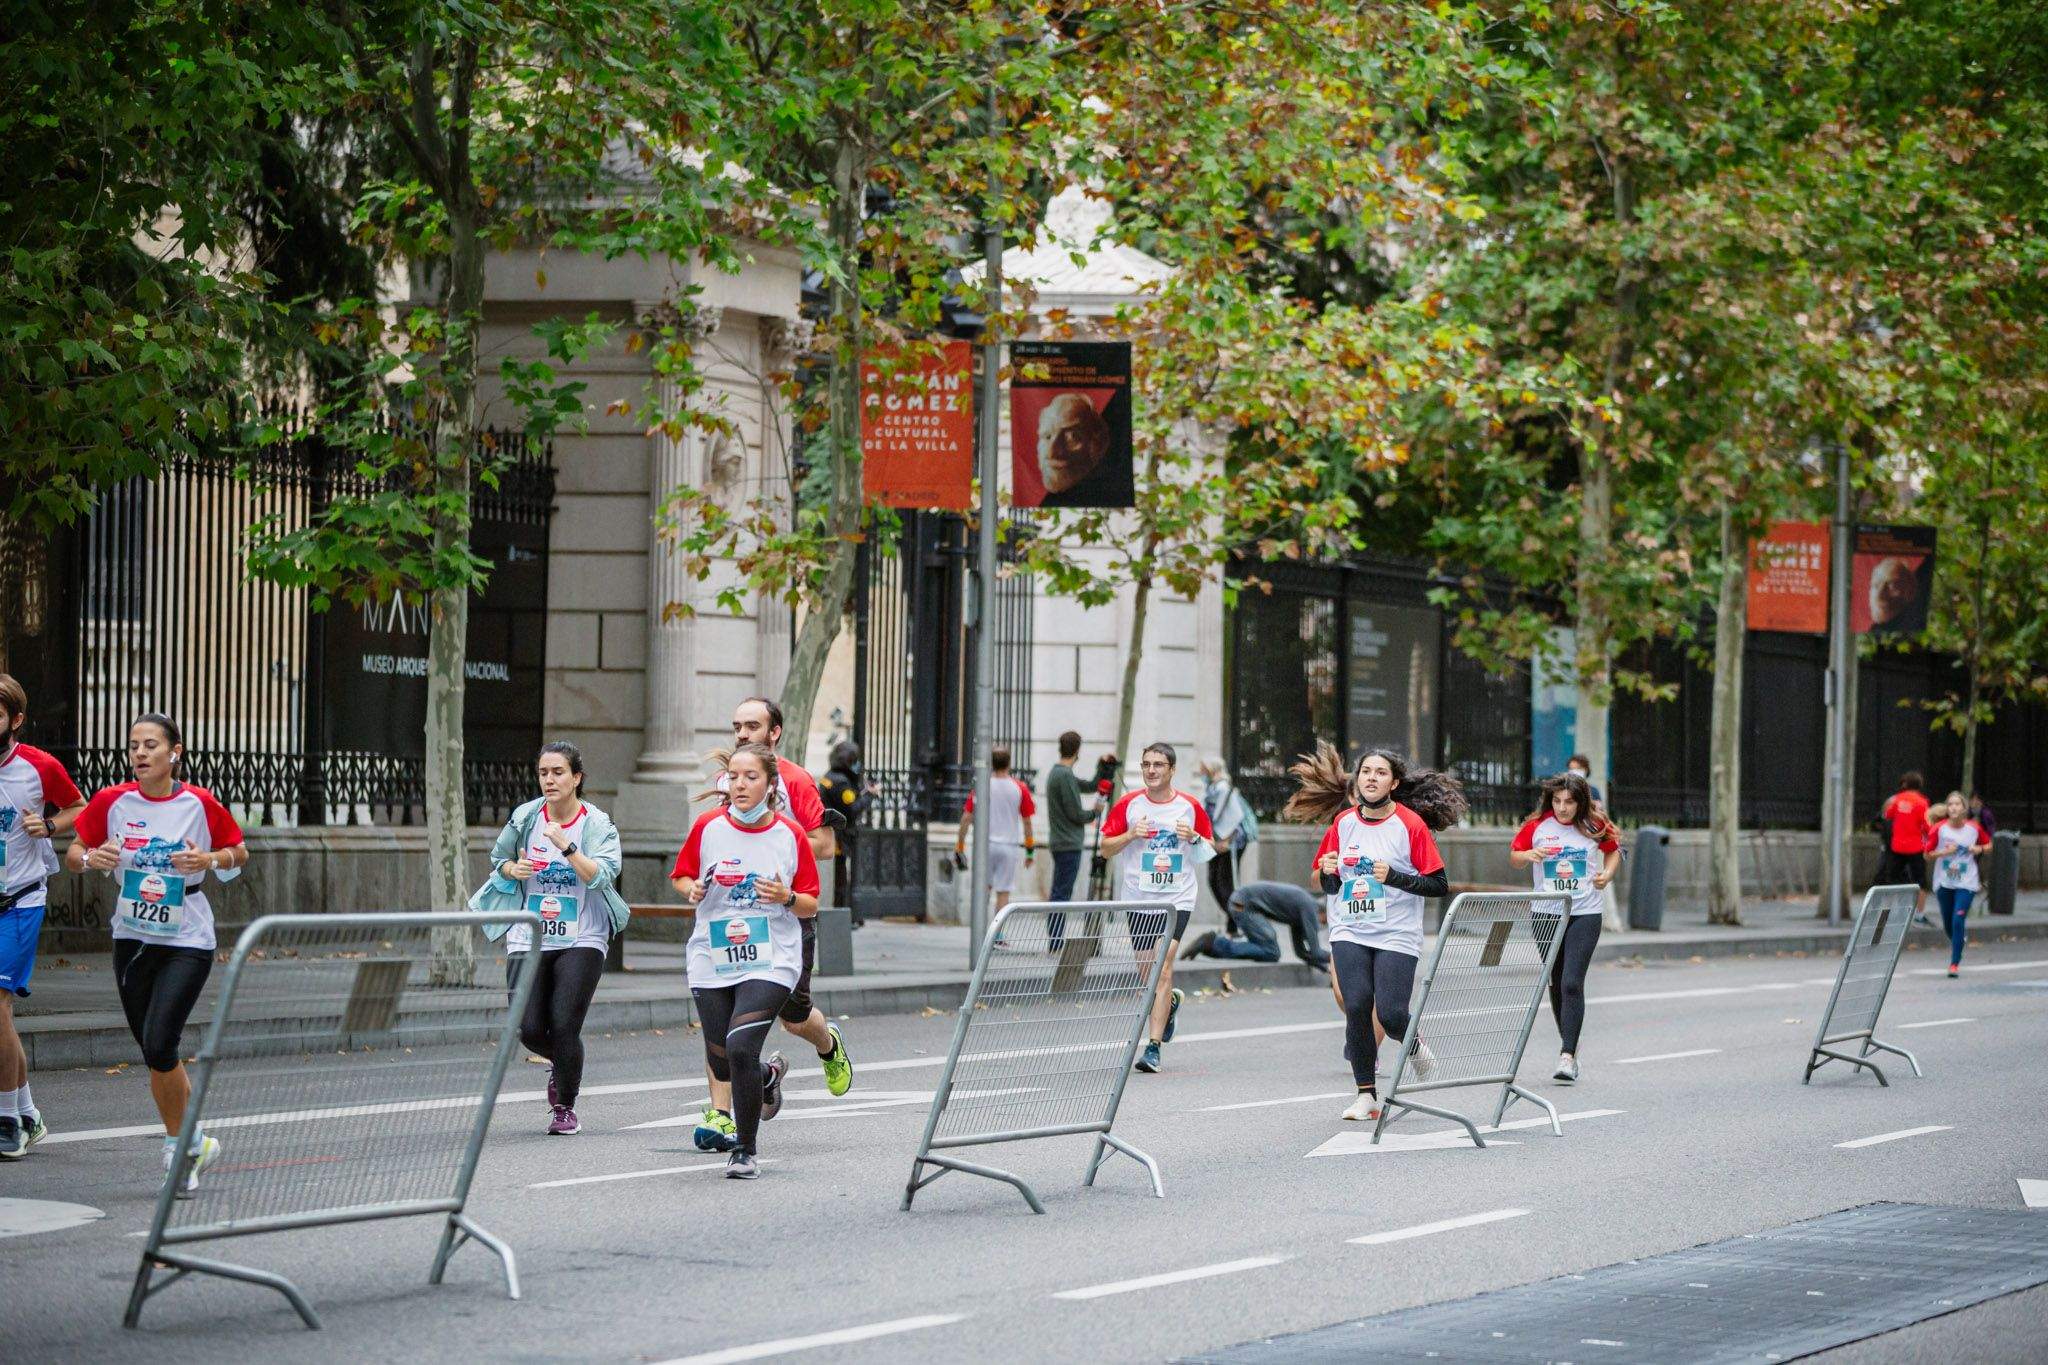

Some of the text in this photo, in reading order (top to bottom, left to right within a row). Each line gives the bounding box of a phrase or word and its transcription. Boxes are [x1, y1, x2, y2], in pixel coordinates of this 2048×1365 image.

[884, 415, 940, 426] CENTRO
[875, 427, 949, 439] CULTURAL
[864, 441, 959, 452] DE LA VILLA
[363, 588, 428, 635] MAN
[363, 654, 394, 674] MUSEO
[465, 661, 509, 681] NACIONAL
[1150, 872, 1174, 884] 1074
[1553, 878, 1579, 891] 1042
[131, 901, 170, 924] 1226
[1347, 899, 1376, 914] 1044
[540, 920, 568, 936] 036
[724, 943, 758, 963] 1149
